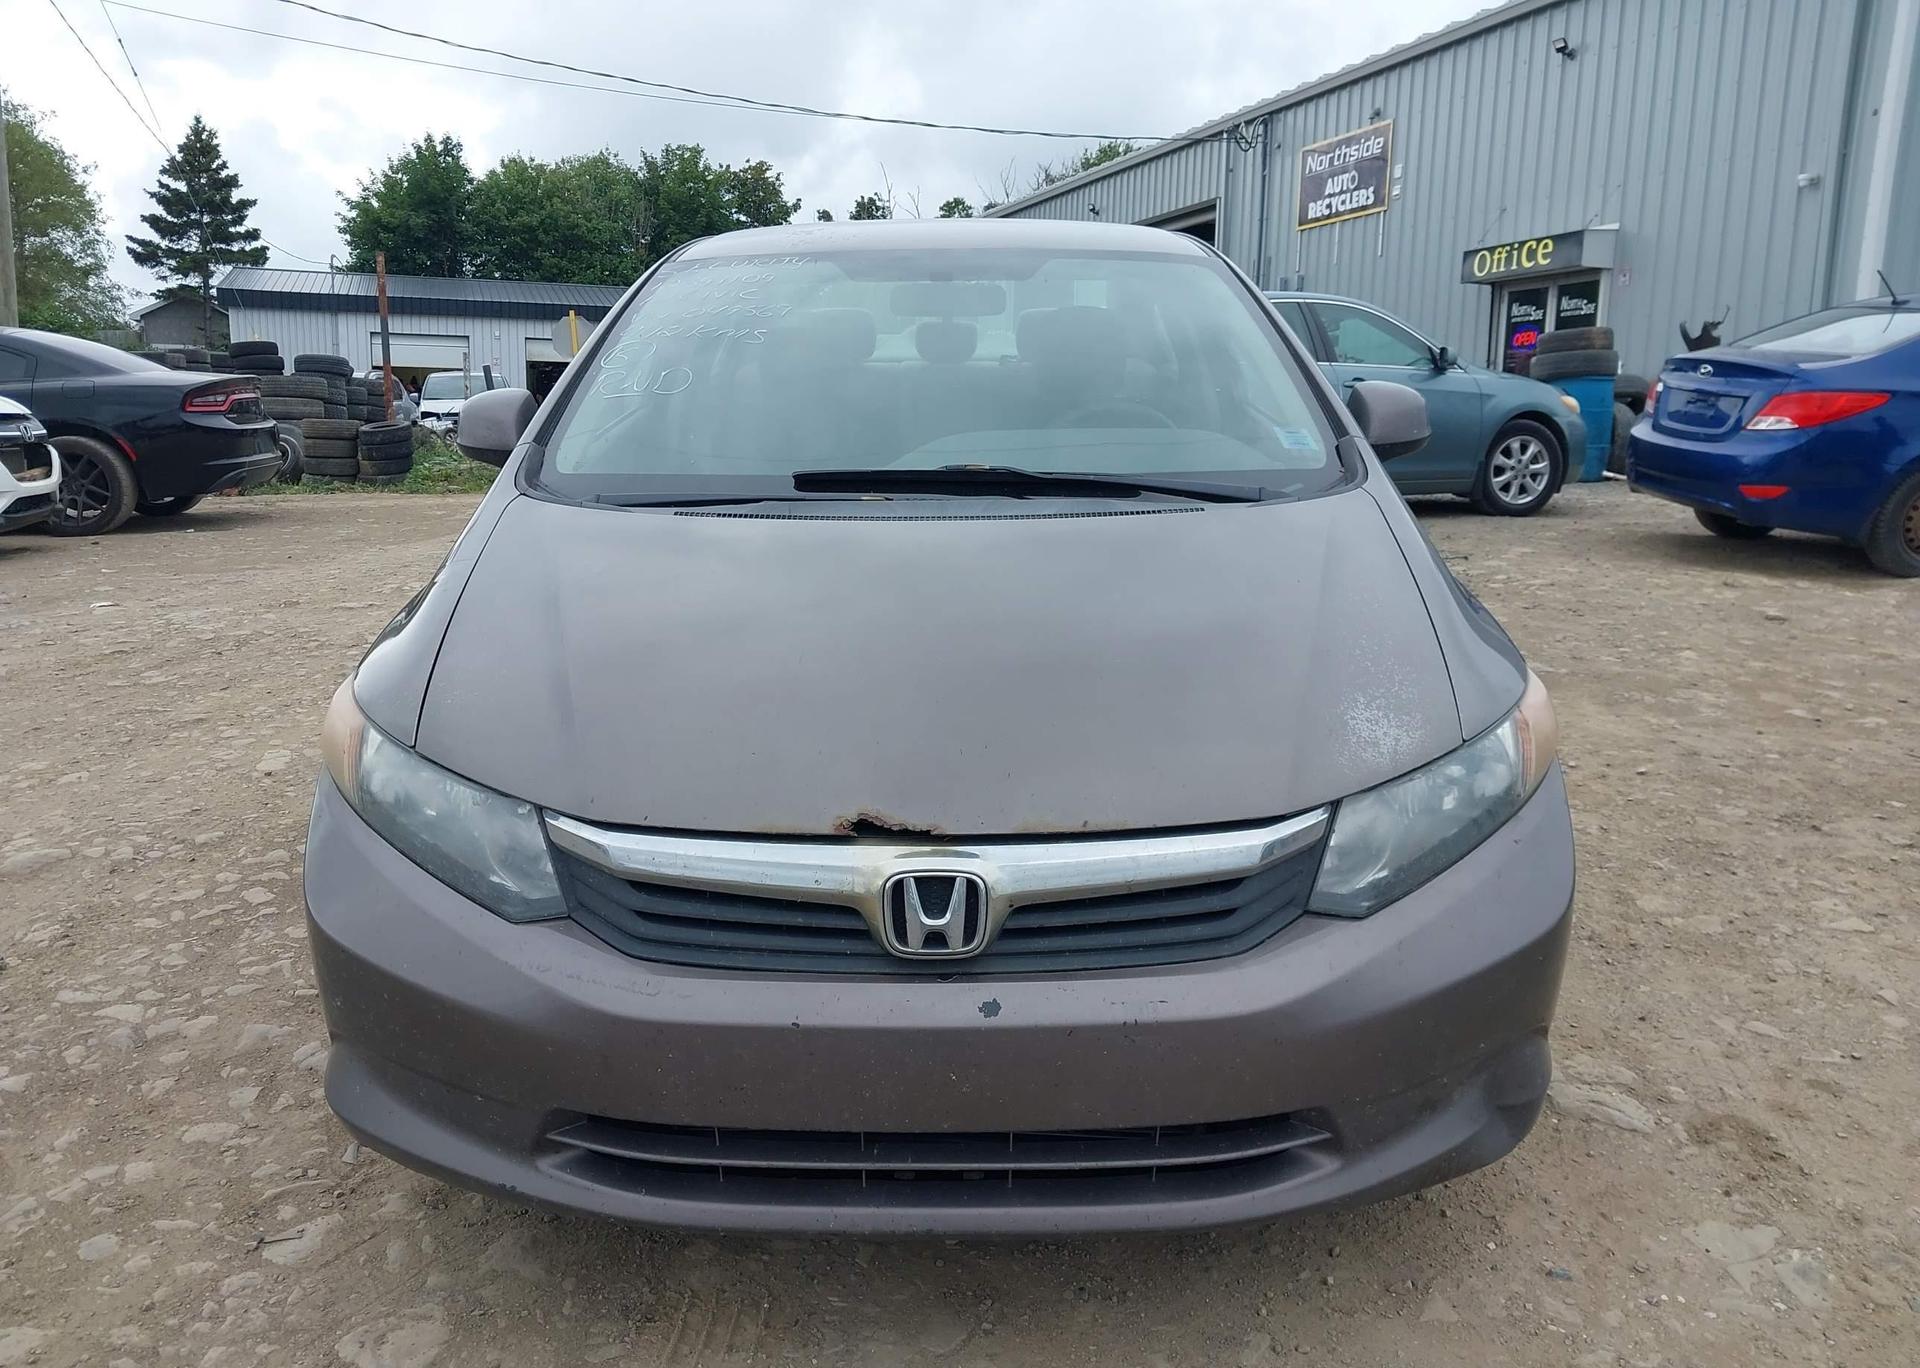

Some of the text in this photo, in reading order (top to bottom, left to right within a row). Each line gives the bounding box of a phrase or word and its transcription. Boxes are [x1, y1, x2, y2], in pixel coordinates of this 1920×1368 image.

[1305, 136, 1385, 175] Northside
[1324, 170, 1359, 196] AUTO
[1307, 186, 1375, 220] RECYCLERS
[1473, 238, 1554, 277] Office
[1512, 330, 1539, 347] OPEN
